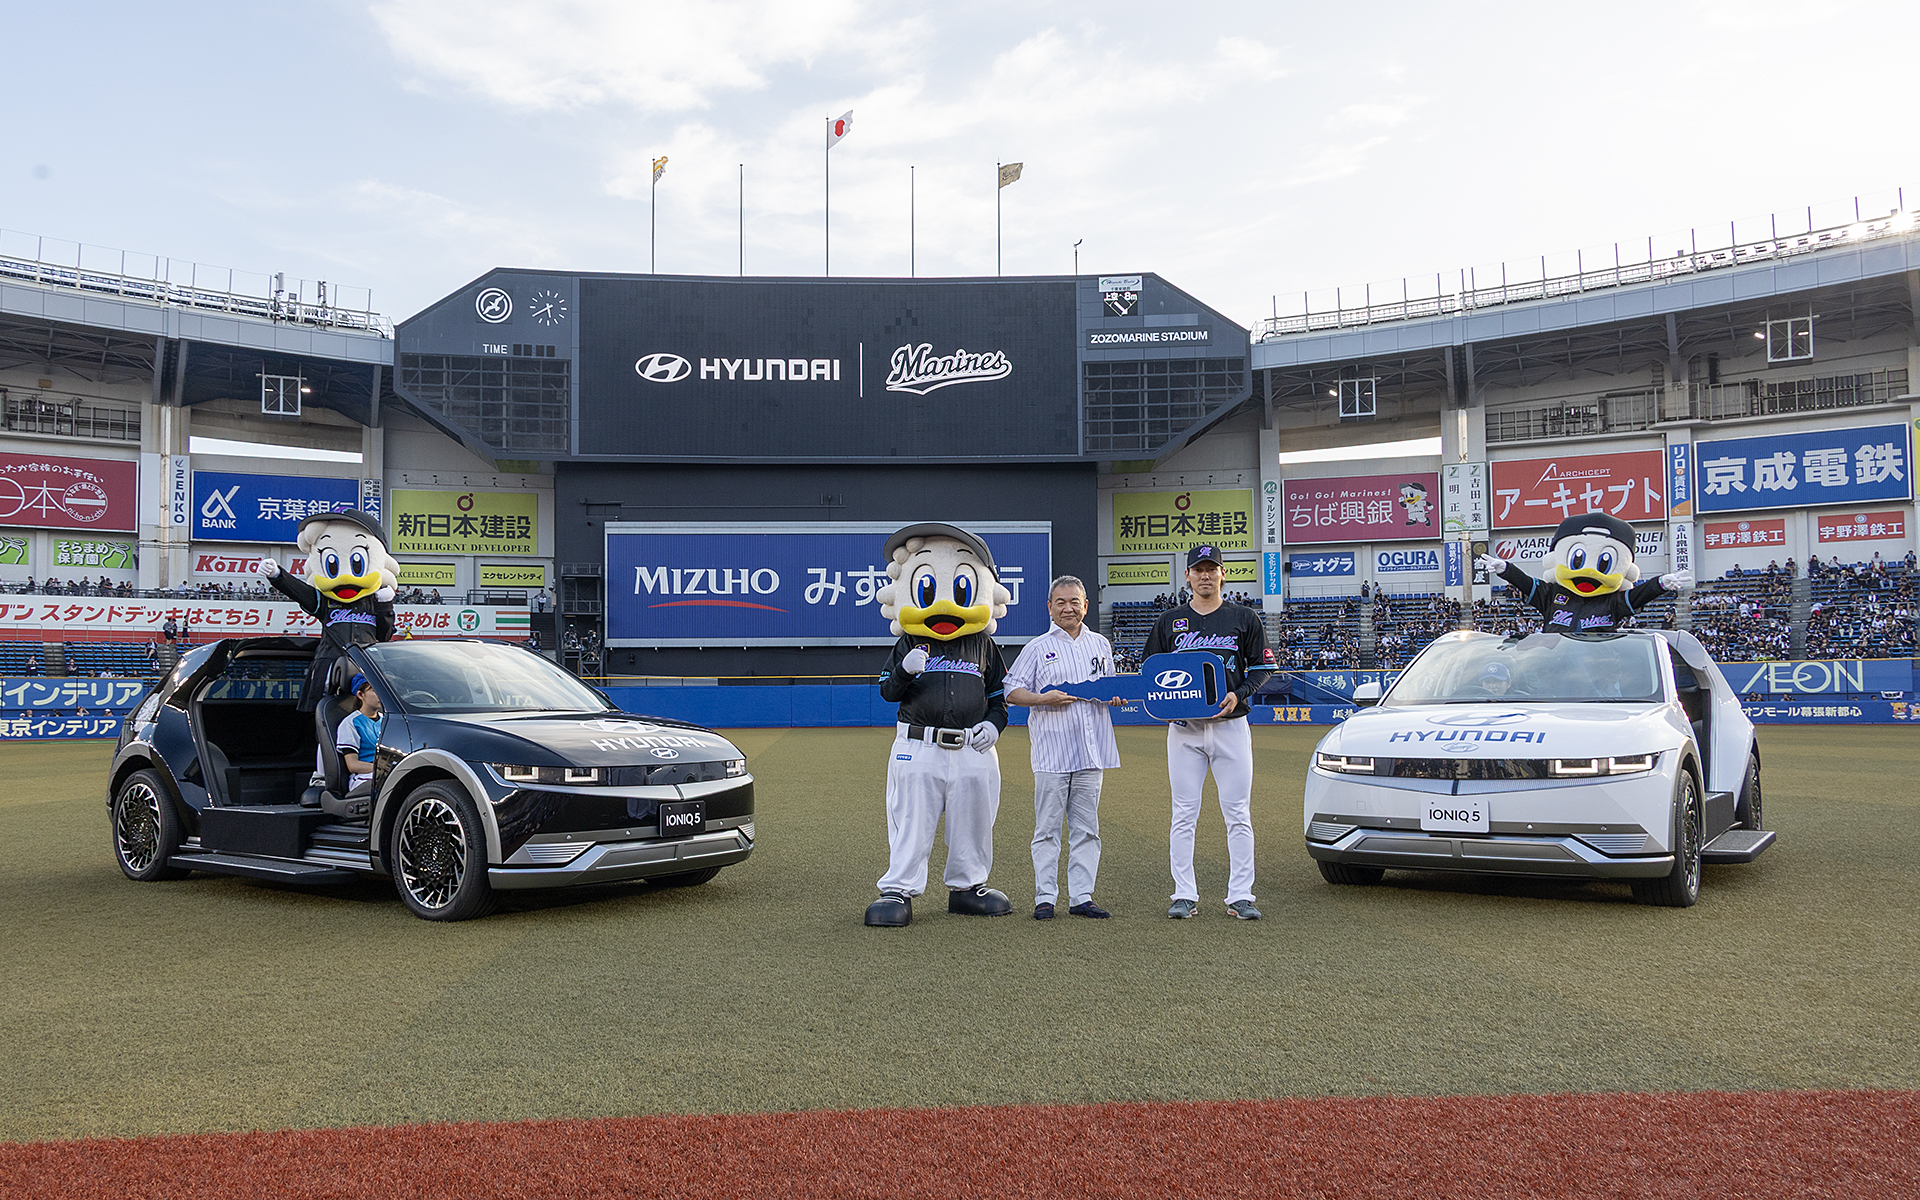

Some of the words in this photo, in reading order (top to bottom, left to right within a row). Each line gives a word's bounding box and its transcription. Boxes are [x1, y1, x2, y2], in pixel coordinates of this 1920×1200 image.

[1090, 332, 1160, 344] ZOZOMARINE
[1160, 330, 1208, 342] STADIUM
[482, 343, 508, 354] TIME
[700, 357, 841, 381] HYUNDAI
[885, 343, 1013, 395] Marines
[1559, 468, 1611, 478] ARCHICEPT
[1702, 442, 1905, 496] 京成電鉄
[1290, 492, 1310, 501] Go!
[1315, 490, 1335, 500] Go!
[1340, 488, 1392, 498] Marines!
[1496, 477, 1662, 521] アーキセプト
[1266, 496, 1276, 544] マルシン運輸
[1289, 500, 1394, 528] ちば興銀
[201, 518, 237, 530] BANK
[397, 512, 531, 540] 新日本建設
[1119, 511, 1248, 539] 新日本建設
[1516, 537, 1553, 549] MARU
[1635, 532, 1664, 543] RUEI
[57, 541, 110, 555] そらまめ
[399, 542, 467, 552] INTELLIGENT
[471, 543, 531, 553] DEVELOPER
[1121, 541, 1185, 551] INTELLIGENT
[57, 553, 100, 566] 保育園
[1312, 557, 1354, 573] オグラ
[1378, 550, 1439, 566] OGURA
[396, 571, 434, 579] XCELLENT
[434, 570, 455, 580] CITY
[482, 571, 543, 581] エクセレントシティ
[634, 566, 781, 596] MIZUHO
[1150, 569, 1169, 579] CITY
[1174, 630, 1239, 651] Marines
[1147, 689, 1202, 701] HYUNDAI
[1742, 706, 1863, 718] オンモール幕張新都心
[1388, 729, 1547, 744] HYUNDAI
[589, 736, 707, 752] HYUNDAI
[665, 812, 694, 827] IONIQ
[693, 812, 701, 824] 5
[1428, 808, 1469, 824] IONIQ
[1470, 809, 1481, 822] 5
